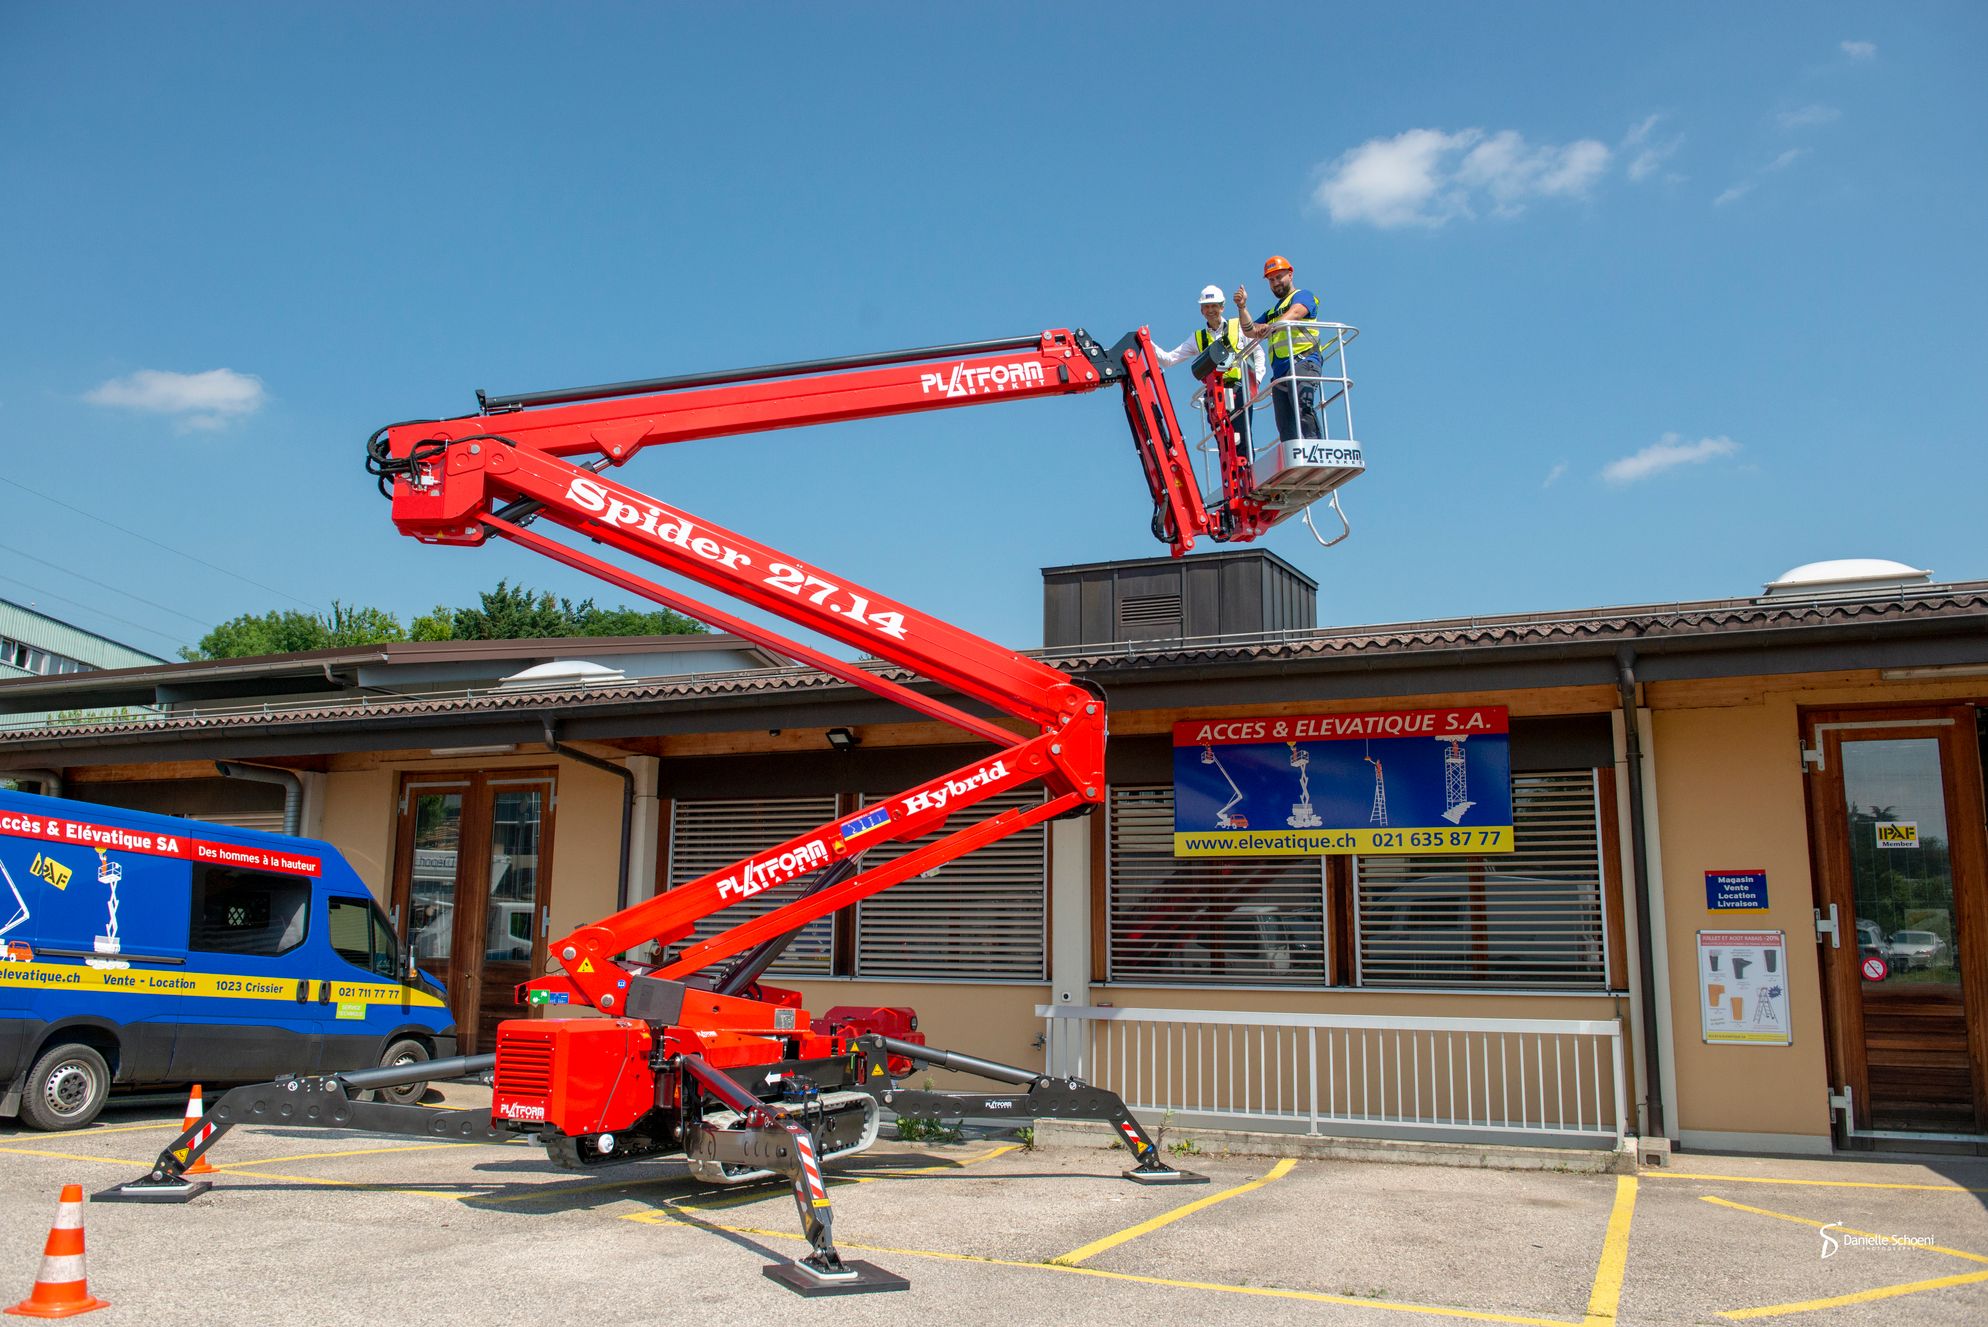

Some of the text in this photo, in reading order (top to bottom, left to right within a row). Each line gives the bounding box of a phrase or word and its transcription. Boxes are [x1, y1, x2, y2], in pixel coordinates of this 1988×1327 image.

[969, 379, 1046, 395] BASKET
[564, 478, 909, 641] Spider 27.14
[1196, 712, 1491, 740] ACCES & ELEVATIQUE S.A.
[901, 760, 1011, 816] Hybrid
[0, 815, 179, 853] ccès & Elévatique SA
[1185, 831, 1501, 852] www.elevatique.ch 021 635 87 77
[1878, 823, 1915, 840] IPAF
[198, 846, 316, 872] Des hommes à la hauteur
[762, 855, 829, 889] BASKET
[1717, 876, 1754, 884] Magasin
[103, 974, 135, 986] Vente
[150, 977, 196, 989] Location
[216, 981, 284, 994] 1023 Crissier
[338, 987, 400, 999] 021 711 77 77
